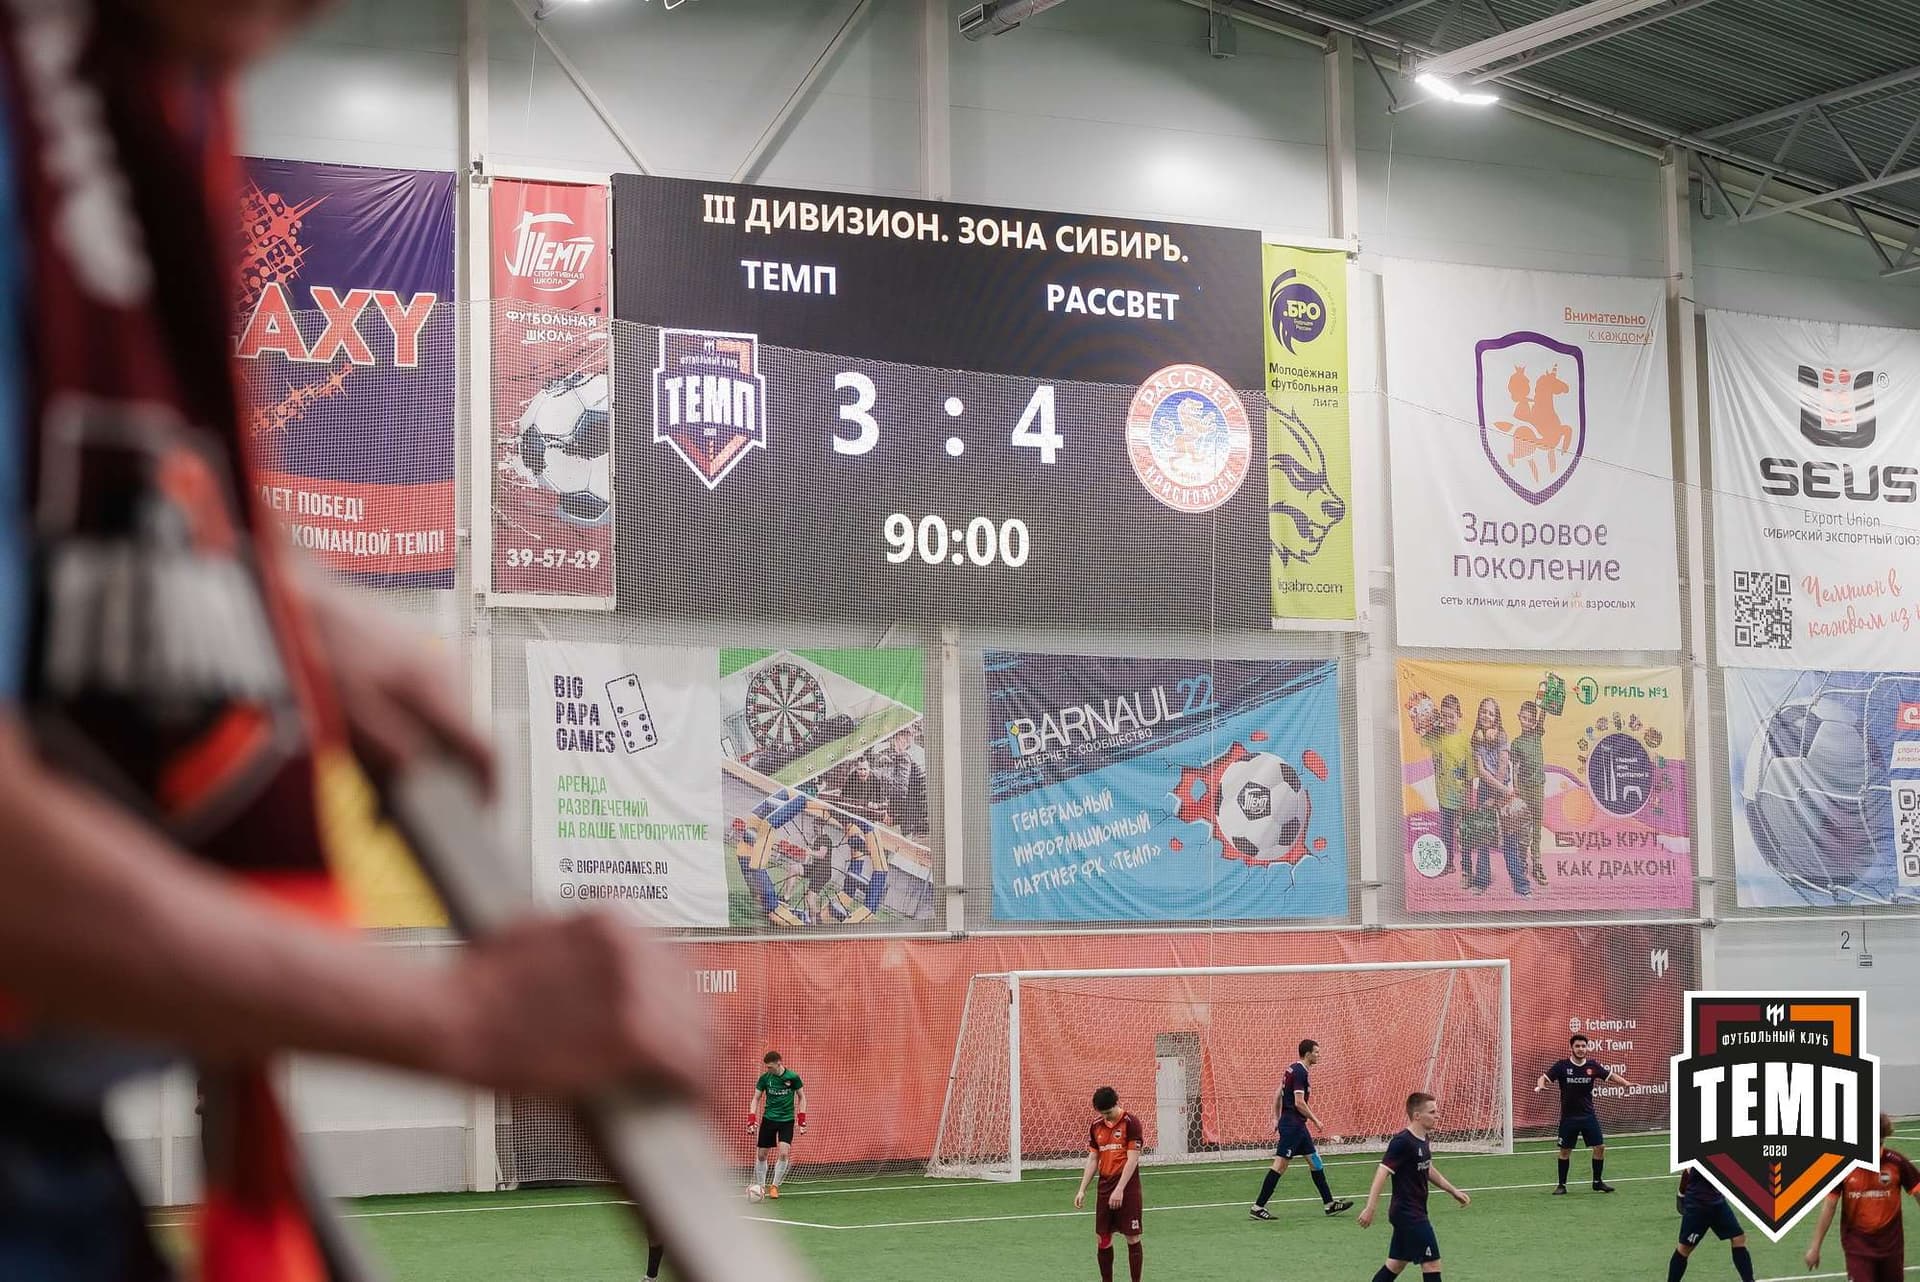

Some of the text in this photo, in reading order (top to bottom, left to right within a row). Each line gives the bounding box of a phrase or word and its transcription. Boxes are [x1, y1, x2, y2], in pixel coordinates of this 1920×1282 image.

[703, 193, 1189, 263] III ДИВИЗИОН. ЗОНА СИБИРЬ.
[533, 270, 585, 280] СПОРТИВНАЯ
[741, 259, 837, 295] ТЕМП
[1047, 284, 1180, 321] РАССВЕТ
[506, 310, 597, 327] ФУТБОЛЬНАЯ
[1564, 307, 1646, 325] Внимательно
[526, 329, 574, 341] ШКОЛА
[1588, 329, 1595, 341] к
[1269, 362, 1338, 380] Молодёжная
[1140, 370, 1238, 412] РАССВЕТ
[1271, 377, 1338, 394] футбольная
[665, 375, 755, 431] ТЕМП
[1313, 398, 1339, 409] лига
[833, 371, 880, 455] 3
[1012, 385, 1064, 464] 4
[1760, 457, 1919, 503] SEUS
[298, 491, 365, 522] ПОБЕД!
[1804, 510, 1880, 527] Export Union
[291, 524, 390, 556] КОМАНДОЙ
[395, 529, 445, 555] ТЕМП!
[884, 513, 1030, 567] 90:00
[1462, 512, 1608, 548] Здоровое
[1763, 527, 1823, 542] СИБИРСКИЙ
[1825, 531, 1892, 545] ЭКСПОРТНЫЙ
[507, 548, 600, 569] 39-57-29
[1453, 554, 1620, 581] поколение
[1440, 595, 1463, 606] сеть
[1466, 596, 1504, 607] клиник
[1506, 599, 1526, 609] для
[1529, 597, 1560, 609] детей
[1562, 600, 1569, 608] и
[1586, 599, 1636, 611] взрослых
[554, 675, 584, 699] BIG
[1604, 686, 1669, 698] ГРИЛЬ №1
[556, 702, 601, 726] PAPA
[556, 728, 616, 753] GAMES
[558, 775, 608, 796] АРЕНДА
[558, 798, 649, 817] РАЗВЛЕЧЕНИЙ
[1012, 787, 1113, 832] ГЕНЕРАЛЬНЫЙ
[558, 821, 709, 841] НА ВАШЕ МЕРОПРИЯТИЕ
[1013, 810, 1151, 867] ИНФОРМАЦИОННЫЙ
[1555, 831, 1665, 851] БУДЬ КРУТ,
[577, 860, 668, 875] BIGPAPAGAMES.RU
[1013, 843, 1162, 898] ПАРТНЕР ФК «ТЕМП»
[1557, 859, 1676, 880] КАК ДРАКОН!
[577, 883, 669, 900] @BIGPAPAGAMES
[1841, 931, 1850, 949] 2
[695, 969, 737, 993] ТЕМП!
[1585, 1018, 1637, 1032] fctemp.ru
[1587, 1039, 1634, 1052] ФК Темп
